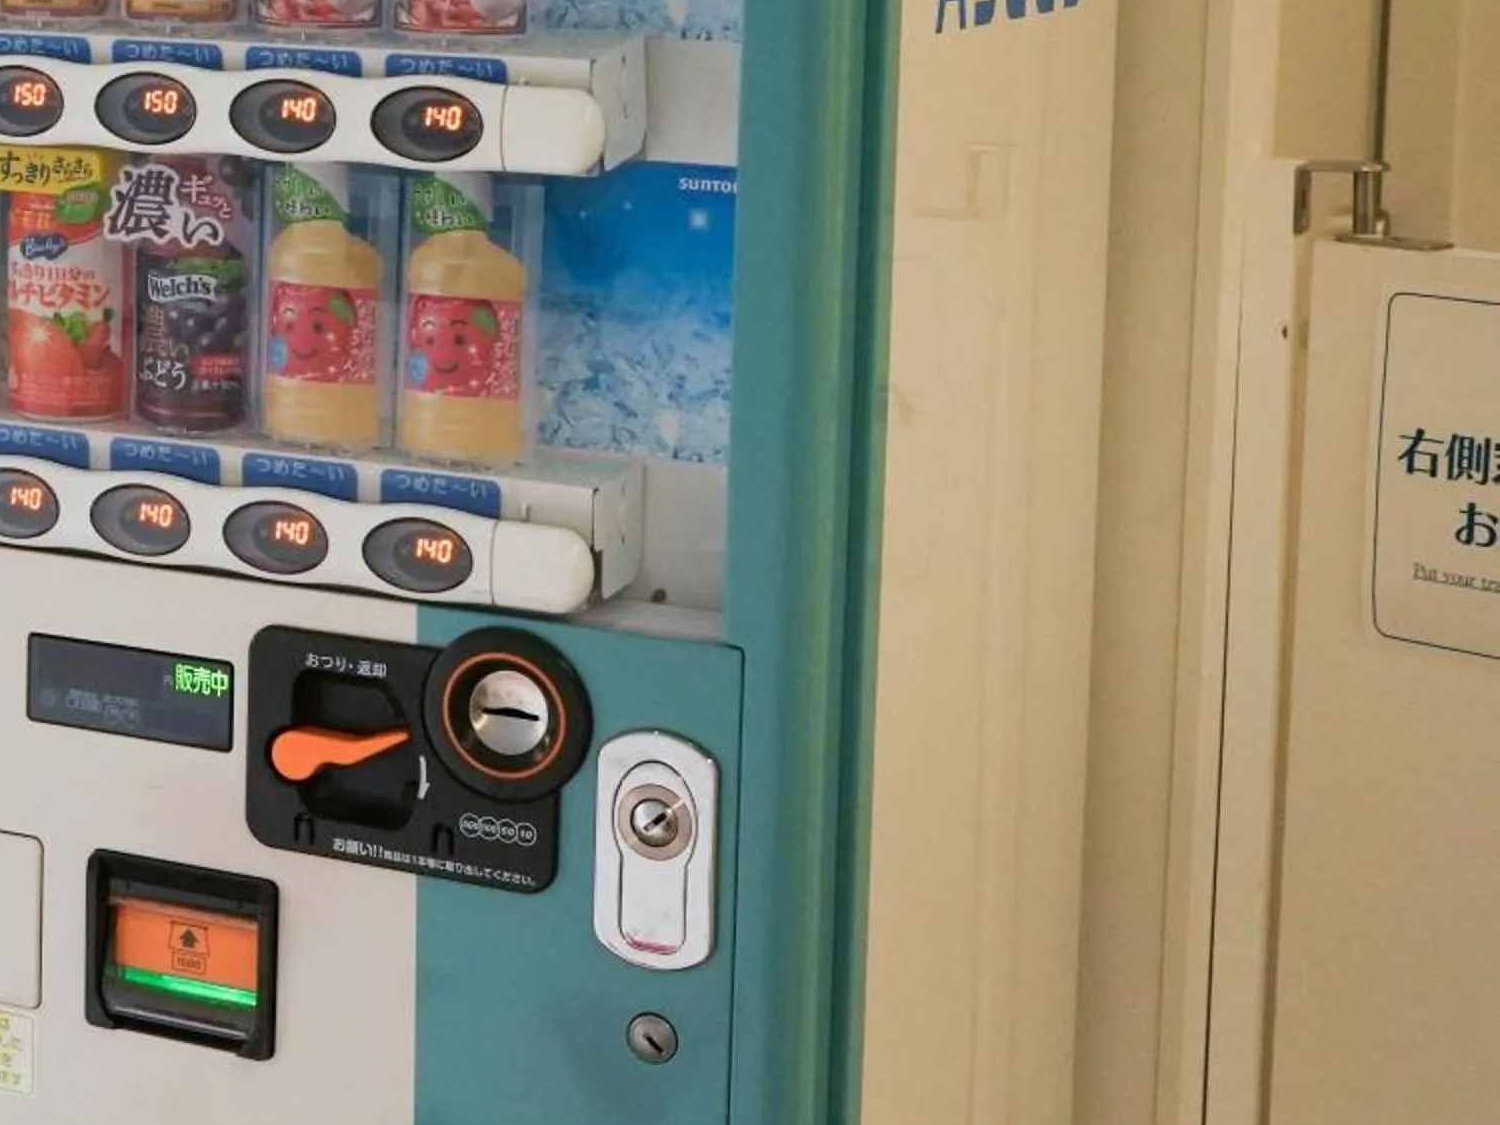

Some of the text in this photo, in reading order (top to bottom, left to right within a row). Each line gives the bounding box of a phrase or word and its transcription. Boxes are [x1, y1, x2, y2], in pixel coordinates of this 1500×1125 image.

[14, 83, 46, 106] 150
[143, 90, 177, 114] 150
[281, 98, 316, 122] 140
[424, 105, 462, 130] 140
[150, 276, 213, 299] Welch's
[1397, 428, 1500, 486] 右側
[10, 487, 42, 510] 140
[139, 504, 173, 528] 140
[275, 521, 310, 545] 140
[415, 538, 454, 563] 140
[175, 662, 230, 697] 販売中
